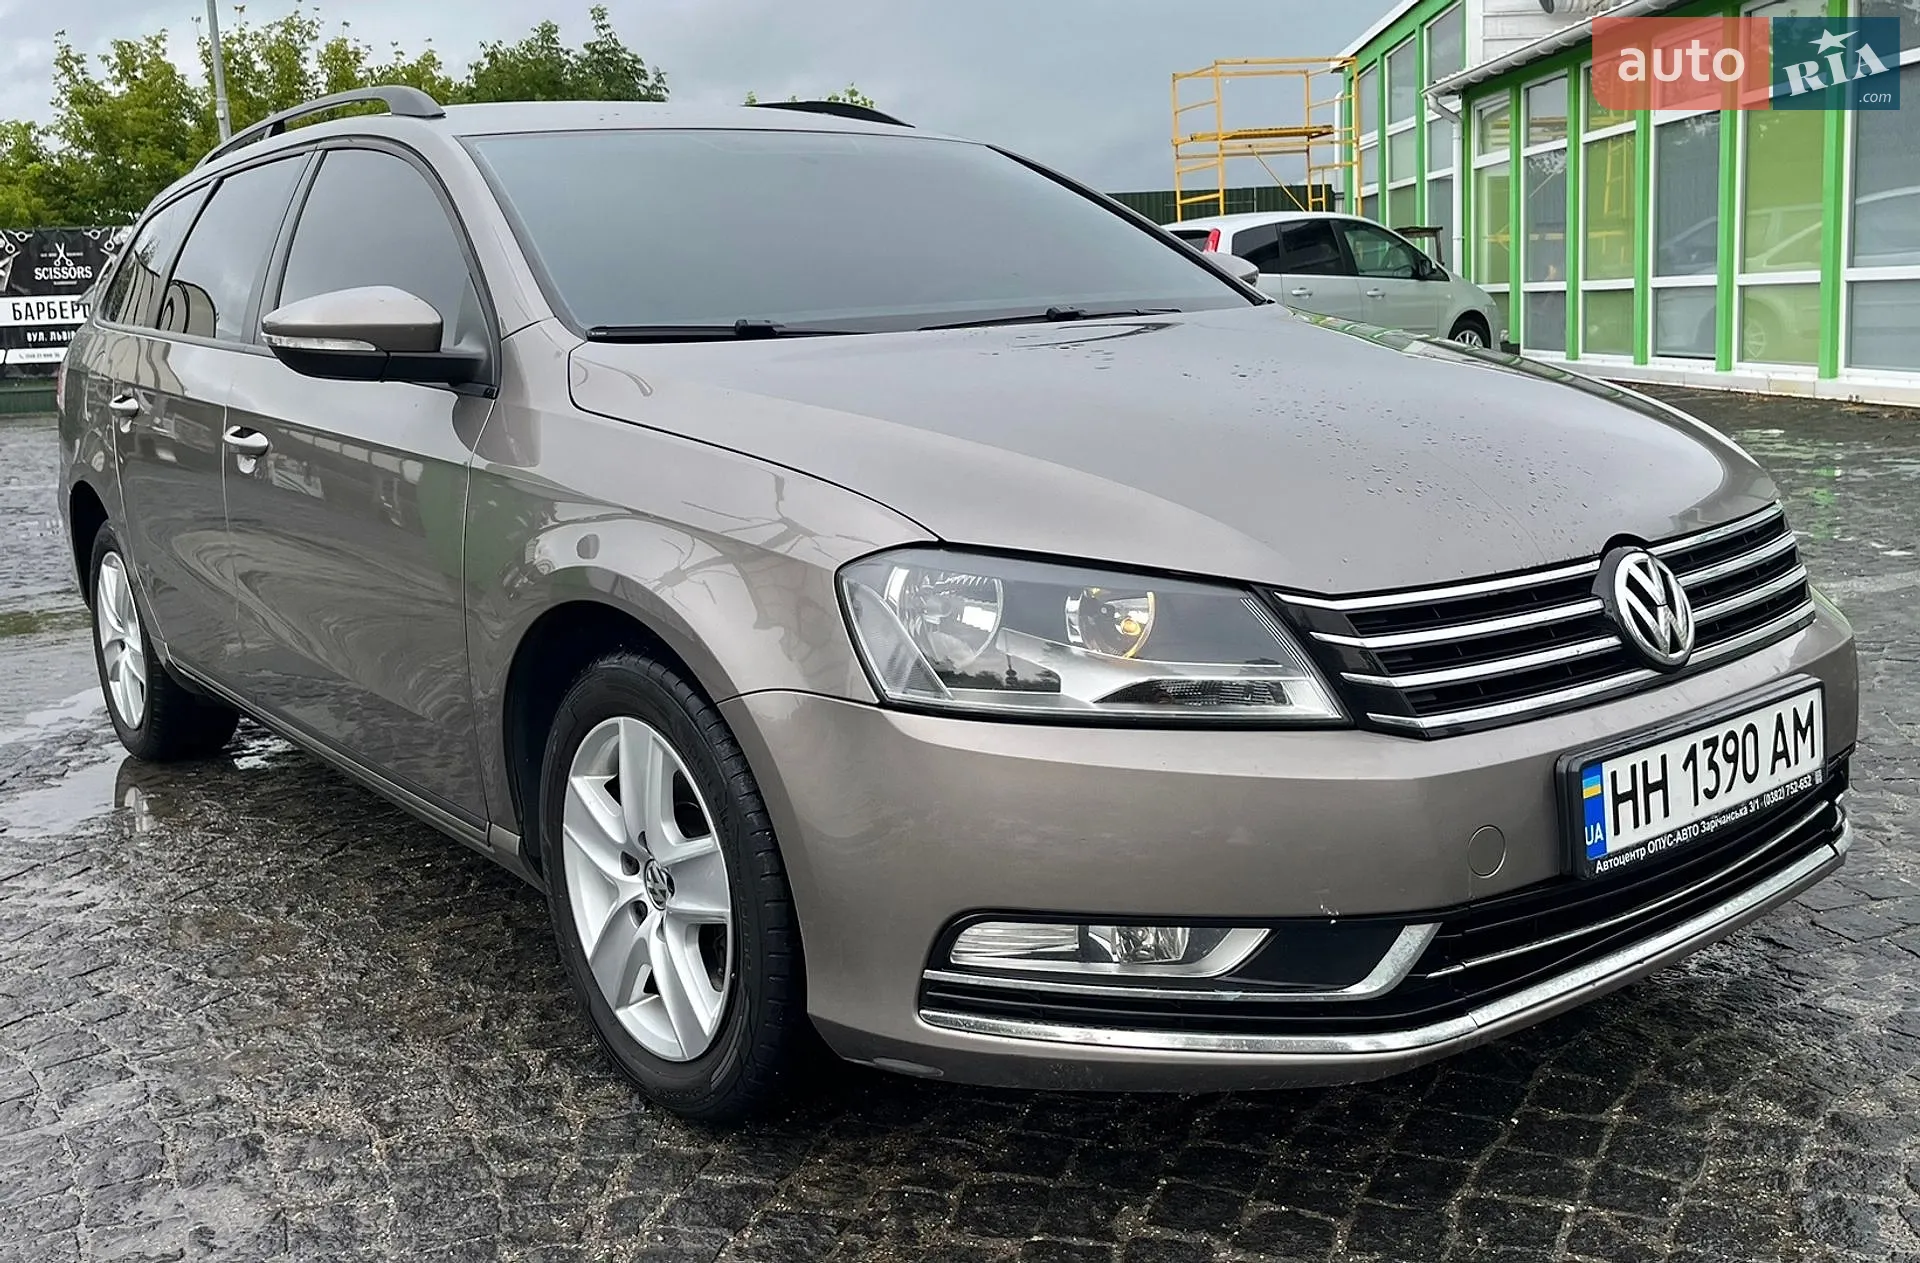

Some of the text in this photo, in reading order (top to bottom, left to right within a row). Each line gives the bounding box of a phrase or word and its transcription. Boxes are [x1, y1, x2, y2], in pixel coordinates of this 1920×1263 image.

[34, 266, 93, 280] SCISSORS
[1610, 699, 1815, 837] HH 1390 AM
[1584, 822, 1605, 846] UA
[1595, 846, 1647, 874] Автоцентр
[1647, 823, 1700, 854] ОПУС-АВТО
[1700, 805, 1748, 833] Зарічанська
[1763, 788, 1785, 808] (0382)
